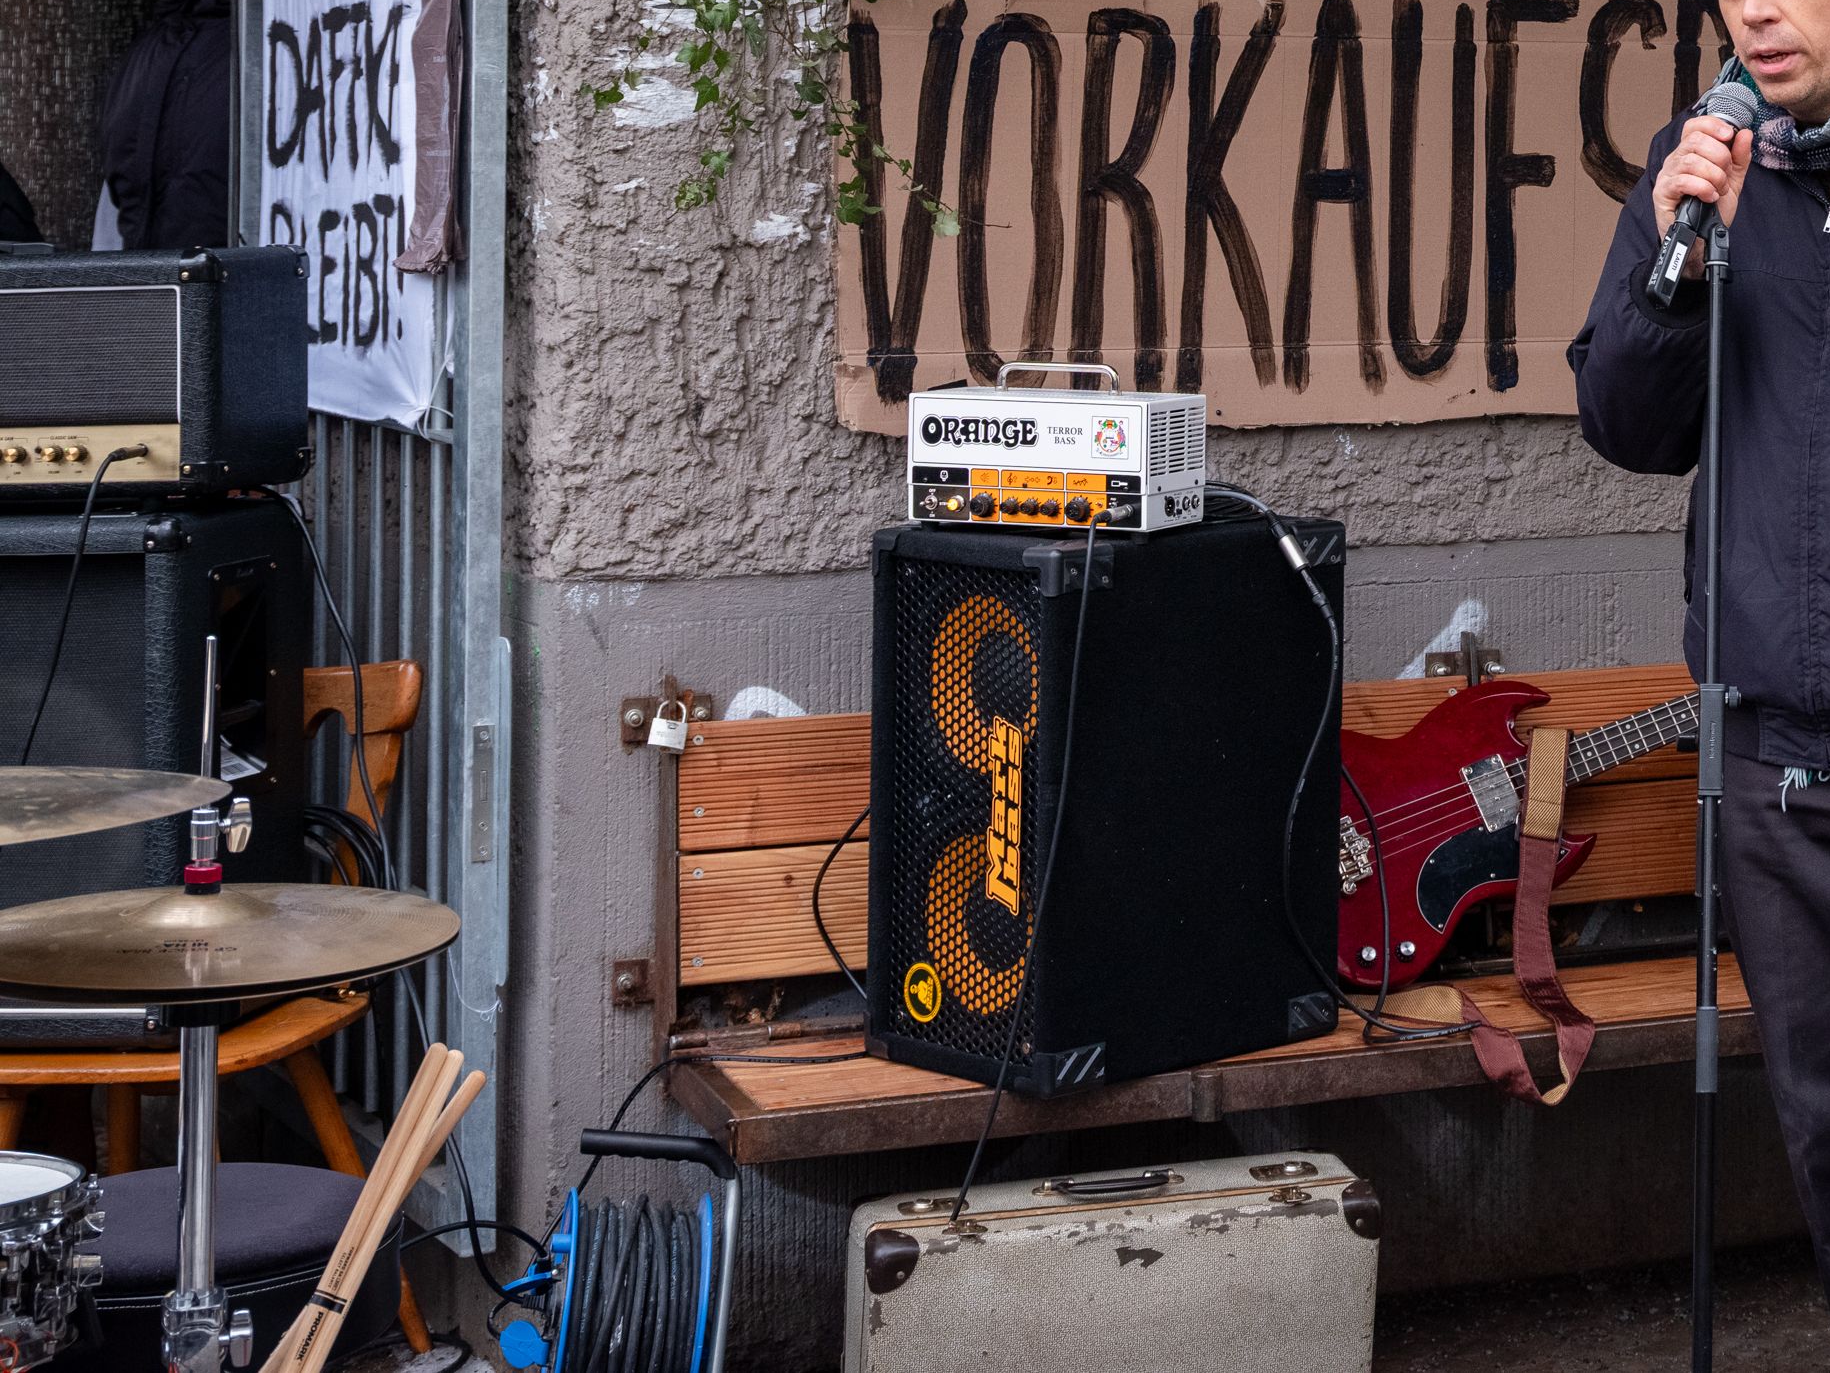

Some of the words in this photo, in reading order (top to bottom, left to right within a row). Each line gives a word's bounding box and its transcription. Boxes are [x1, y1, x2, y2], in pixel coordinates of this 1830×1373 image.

[921, 414, 1039, 448] ORANGE
[1047, 426, 1083, 436] TERROR
[1053, 435, 1076, 445] BASS
[297, 1311, 325, 1362] PROMARK
